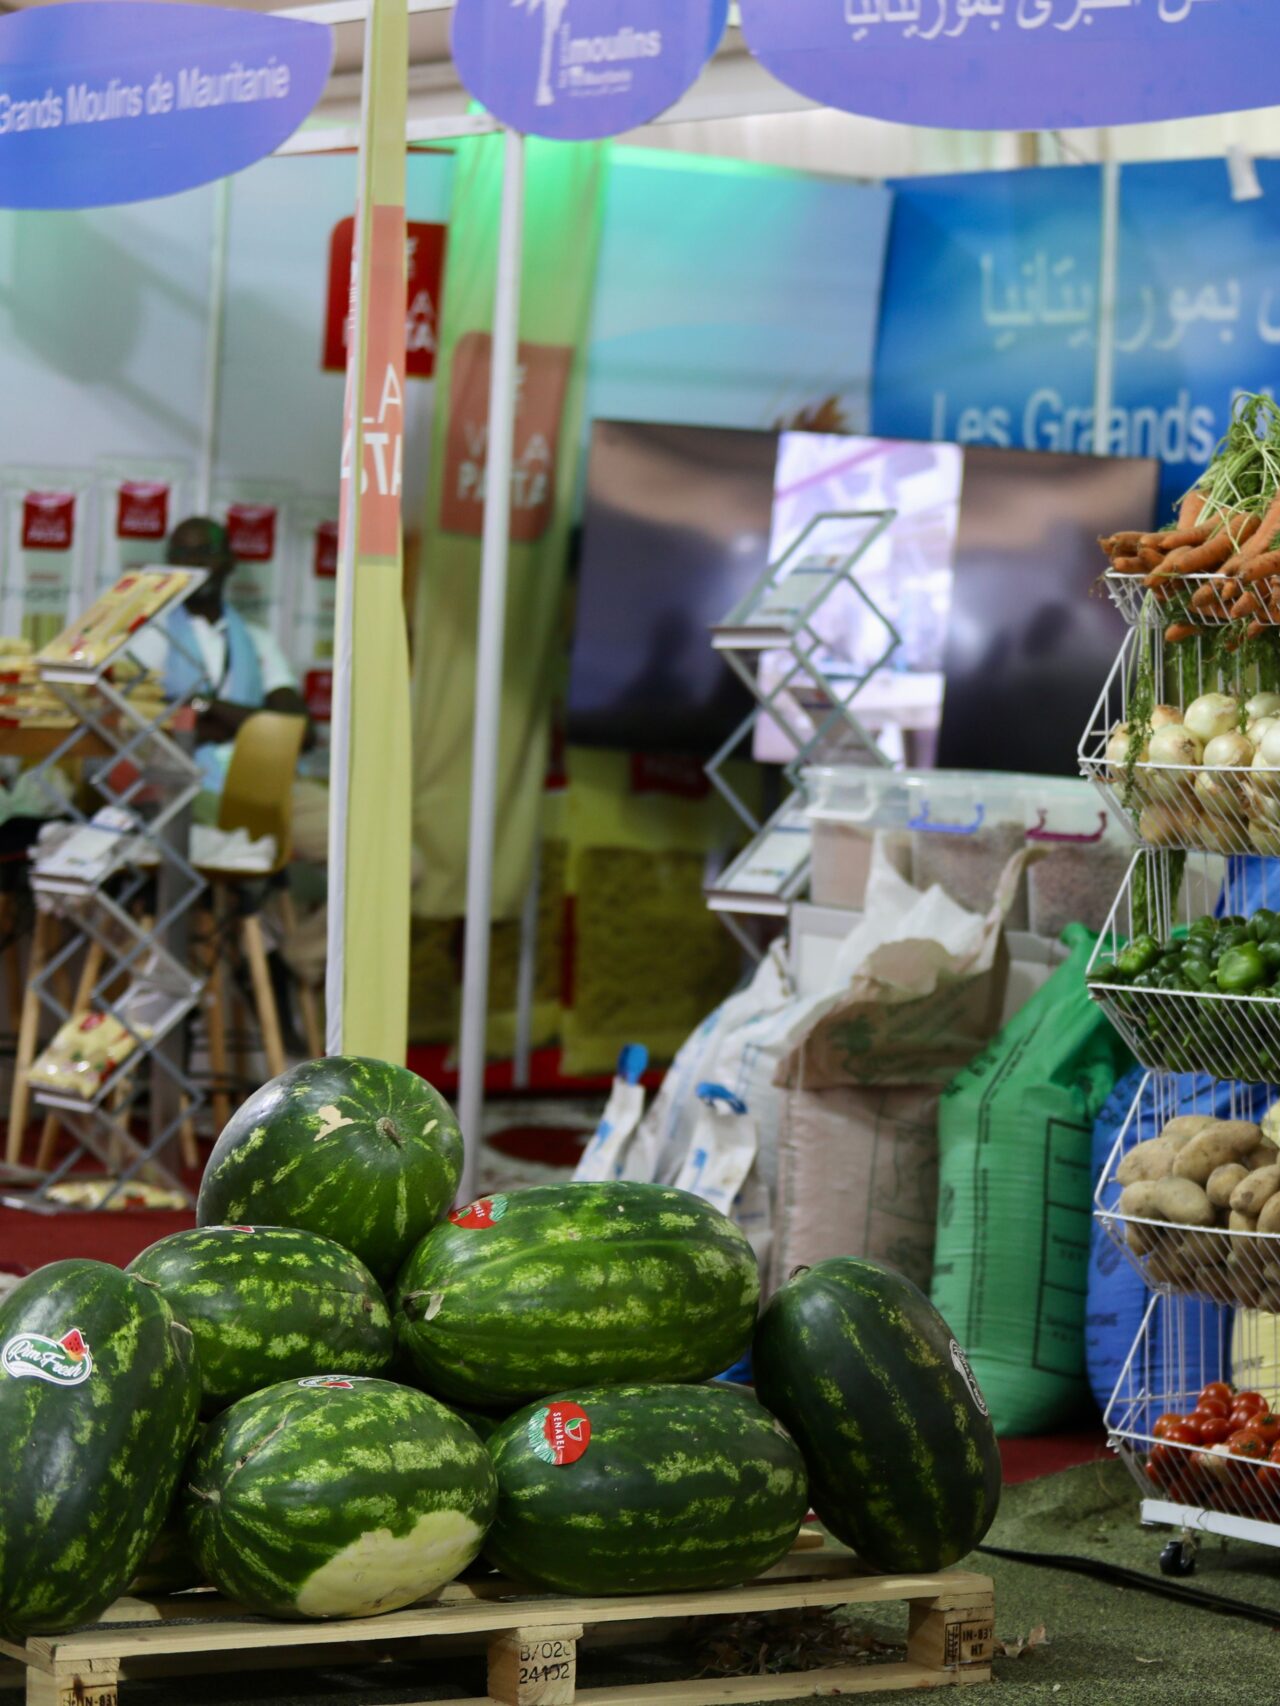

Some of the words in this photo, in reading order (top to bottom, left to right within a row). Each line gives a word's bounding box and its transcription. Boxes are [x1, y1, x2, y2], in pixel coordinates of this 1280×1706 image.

[66, 78, 143, 125] Moulins
[146, 71, 175, 115] de
[177, 56, 291, 110] Mauritanie
[552, 1411, 566, 1451] SENABEL
